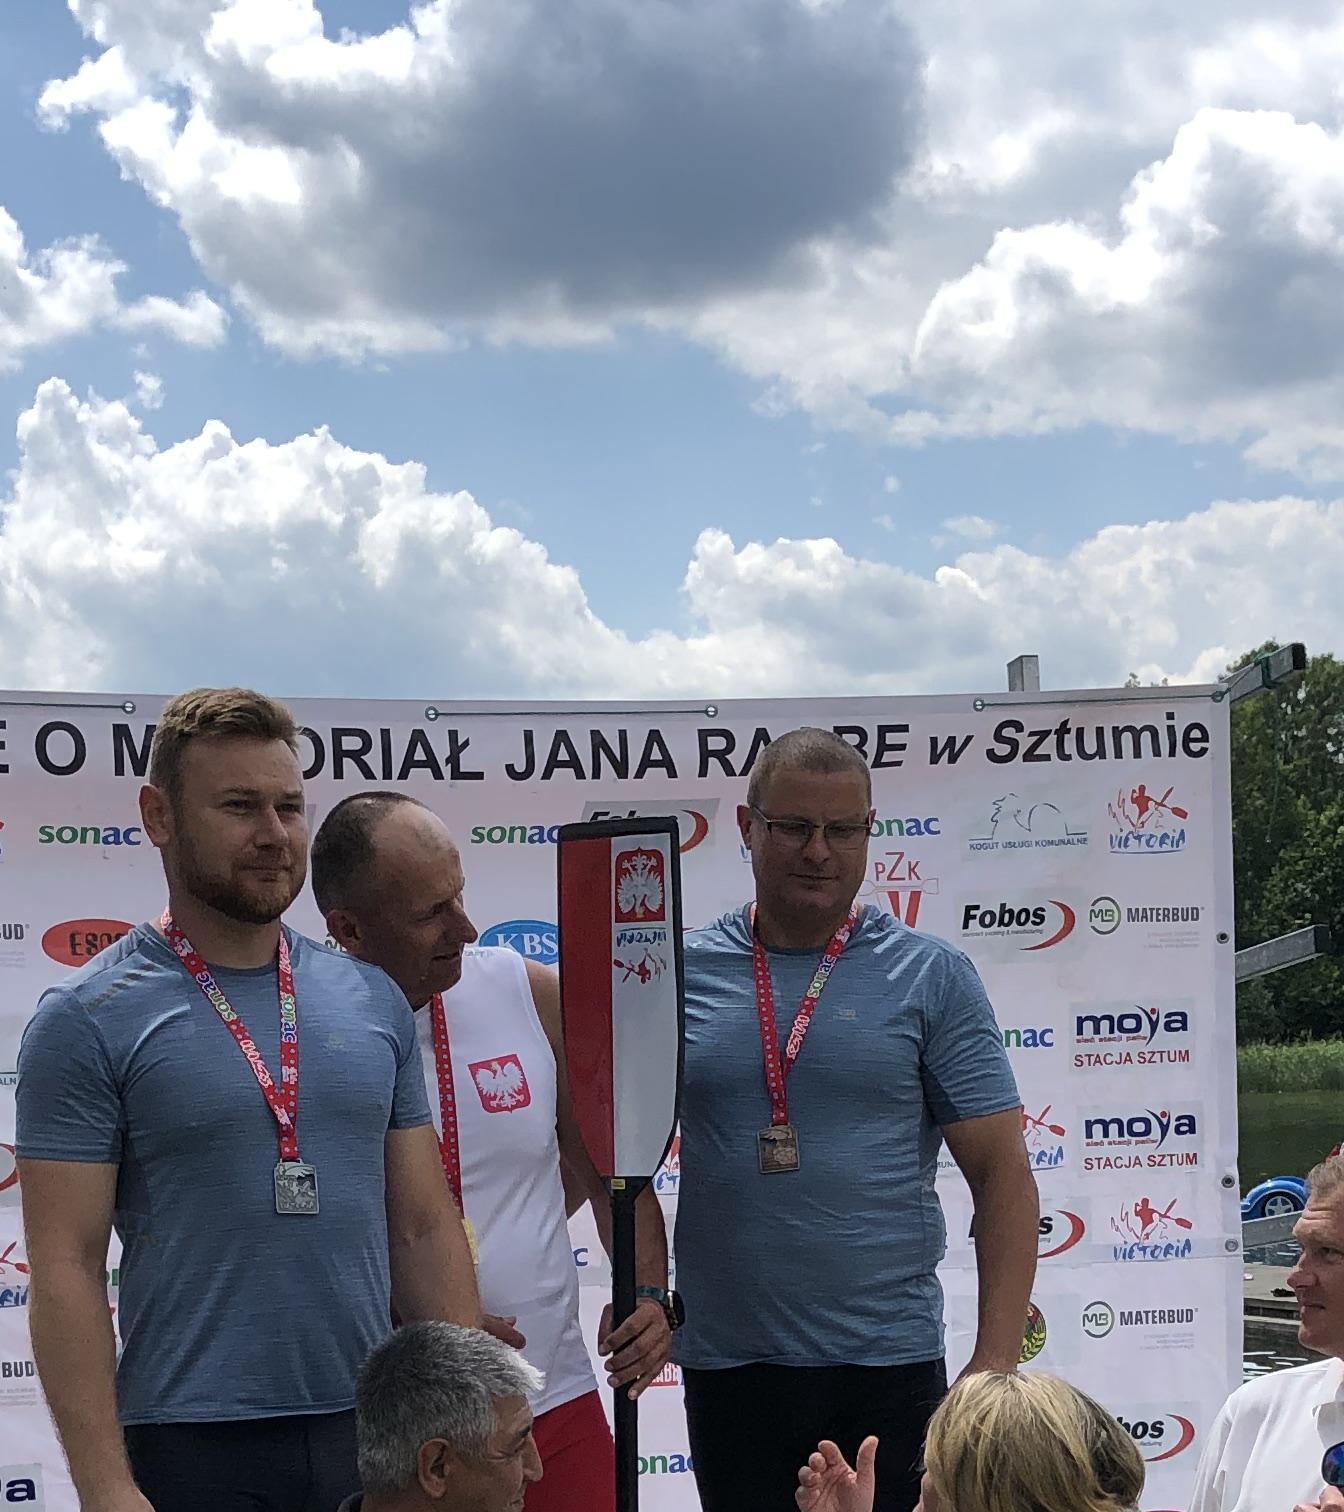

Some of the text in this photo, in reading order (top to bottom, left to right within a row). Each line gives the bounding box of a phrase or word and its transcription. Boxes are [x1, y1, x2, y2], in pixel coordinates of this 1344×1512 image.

[35, 721, 86, 776] O
[505, 729, 678, 780] JANA
[929, 735, 973, 766] w
[986, 711, 1211, 765] Sztumie
[38, 824, 142, 847] sonac
[870, 816, 941, 838] onac
[969, 840, 999, 852] KOGUT
[874, 852, 921, 881] PZK
[962, 902, 1046, 930] Fobos
[1127, 907, 1200, 923] MATERBUD
[1075, 1005, 1189, 1047] moya
[1002, 1027, 1054, 1049] nac
[1074, 1048, 1190, 1067] STACJA SZTUM
[1085, 1108, 1197, 1150] moya
[1084, 1152, 1198, 1171] STACJA SZTUM
[1119, 1308, 1194, 1327] MATERBUD
